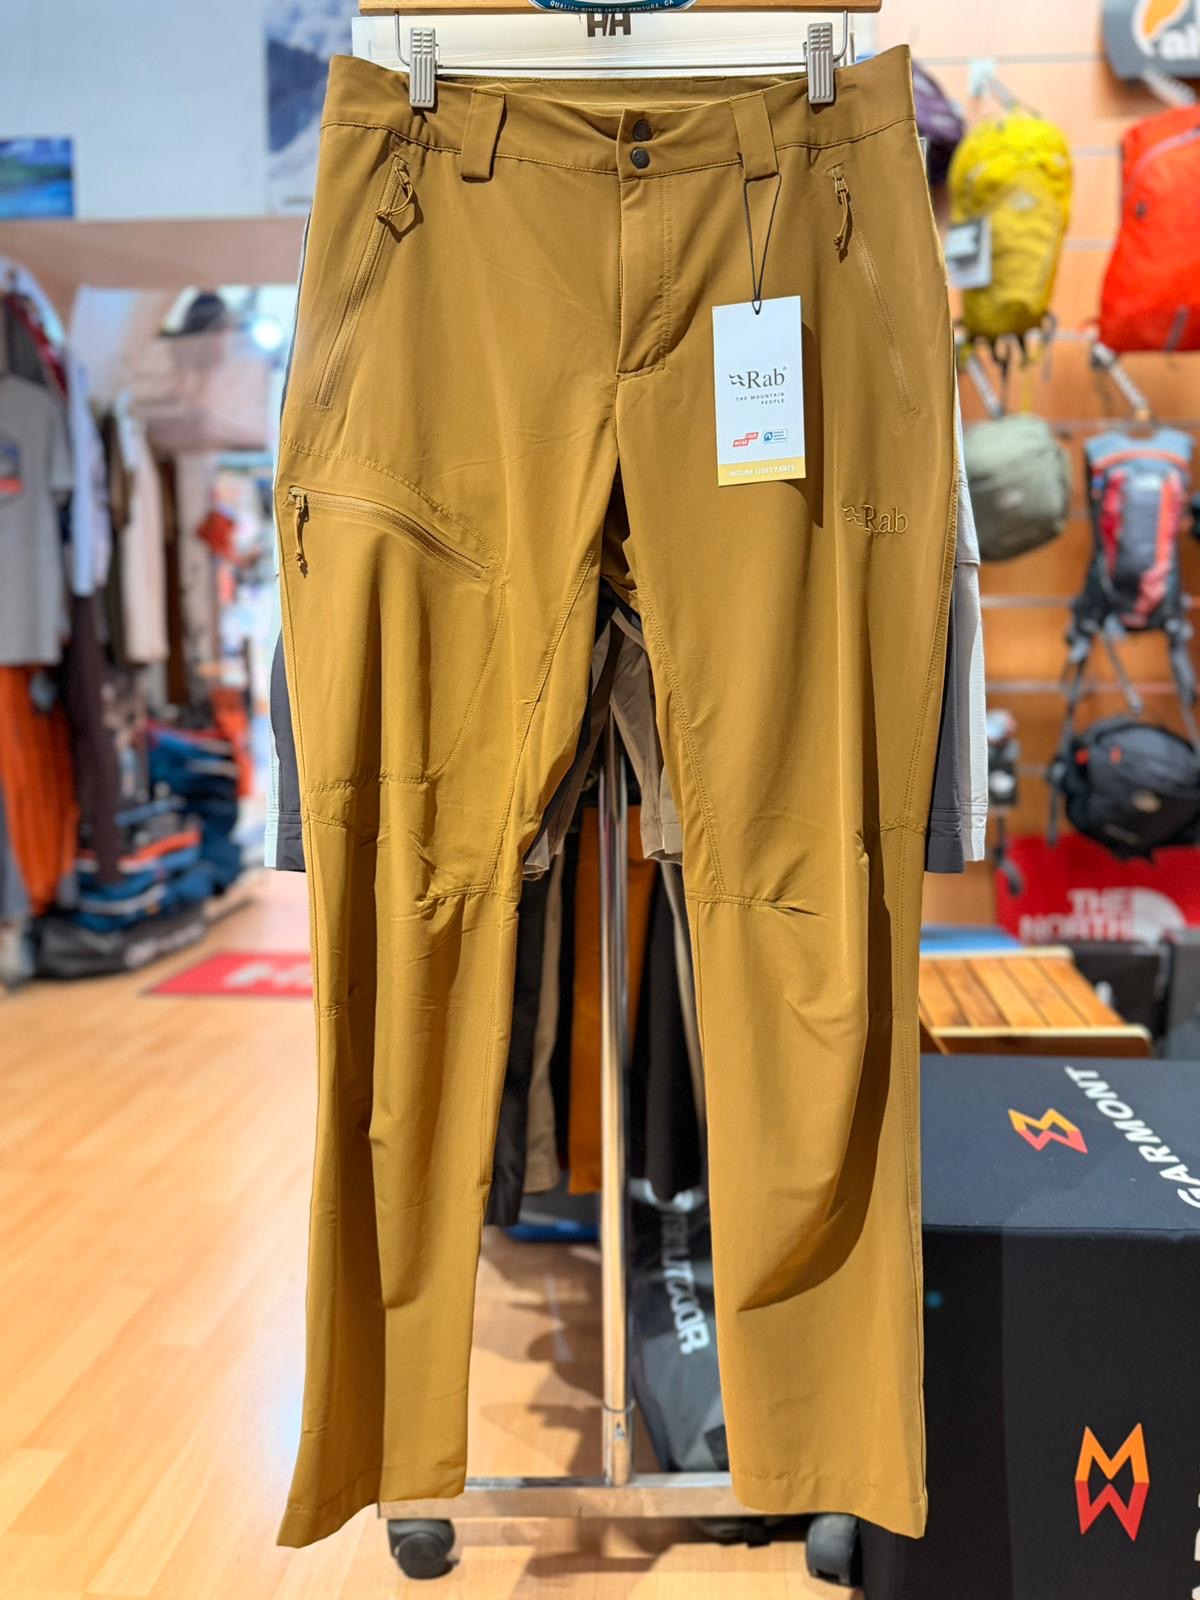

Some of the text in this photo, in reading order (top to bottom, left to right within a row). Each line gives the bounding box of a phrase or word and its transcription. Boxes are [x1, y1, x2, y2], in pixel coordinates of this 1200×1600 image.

[549, 0, 579, 10] QUALITY
[746, 368, 785, 389] Rab
[750, 392, 784, 400] MOUNTAIN
[755, 467, 772, 475] LIGHT
[862, 503, 908, 534] Rab
